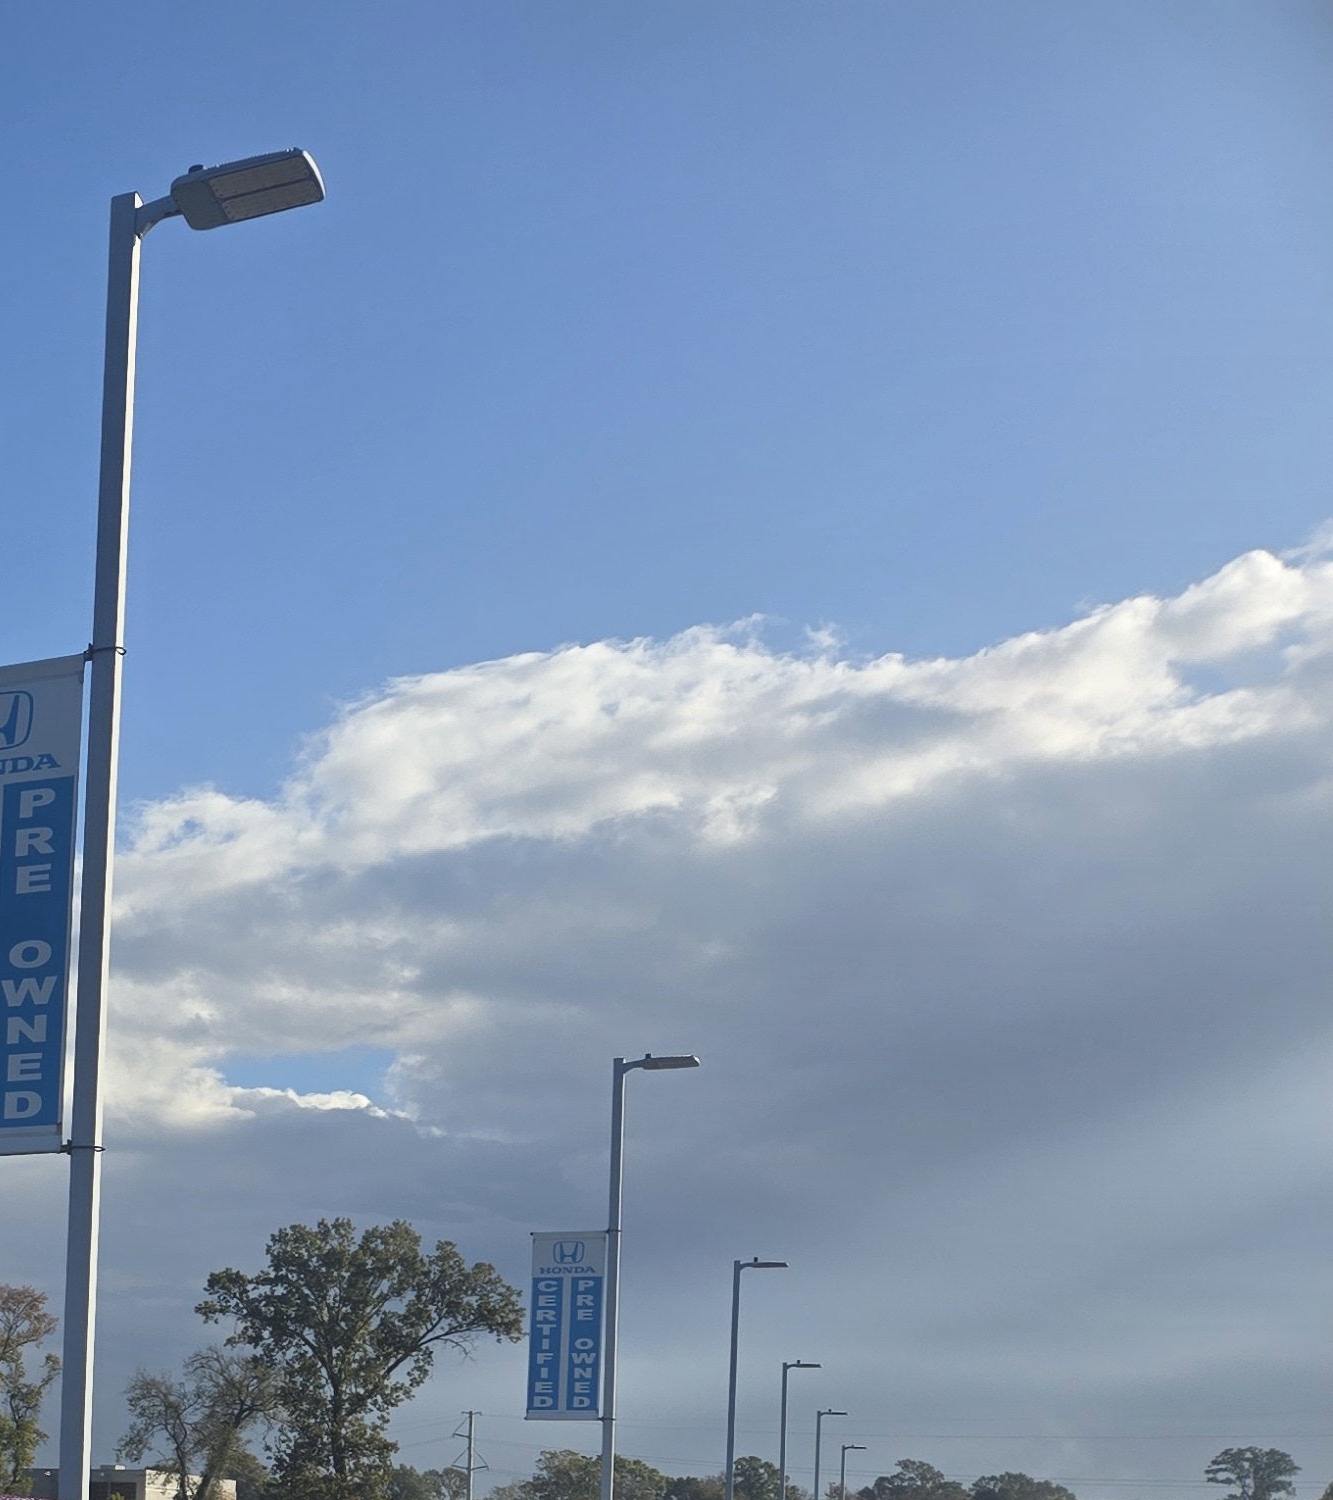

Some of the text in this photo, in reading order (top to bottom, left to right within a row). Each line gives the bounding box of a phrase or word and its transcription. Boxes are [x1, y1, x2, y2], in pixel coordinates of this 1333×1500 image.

[0, 787, 59, 1121] PRE OWNED
[539, 1267, 596, 1275] HONDA
[533, 1280, 558, 1408] CERTIFIED
[571, 1279, 596, 1409] PRE OWNED
